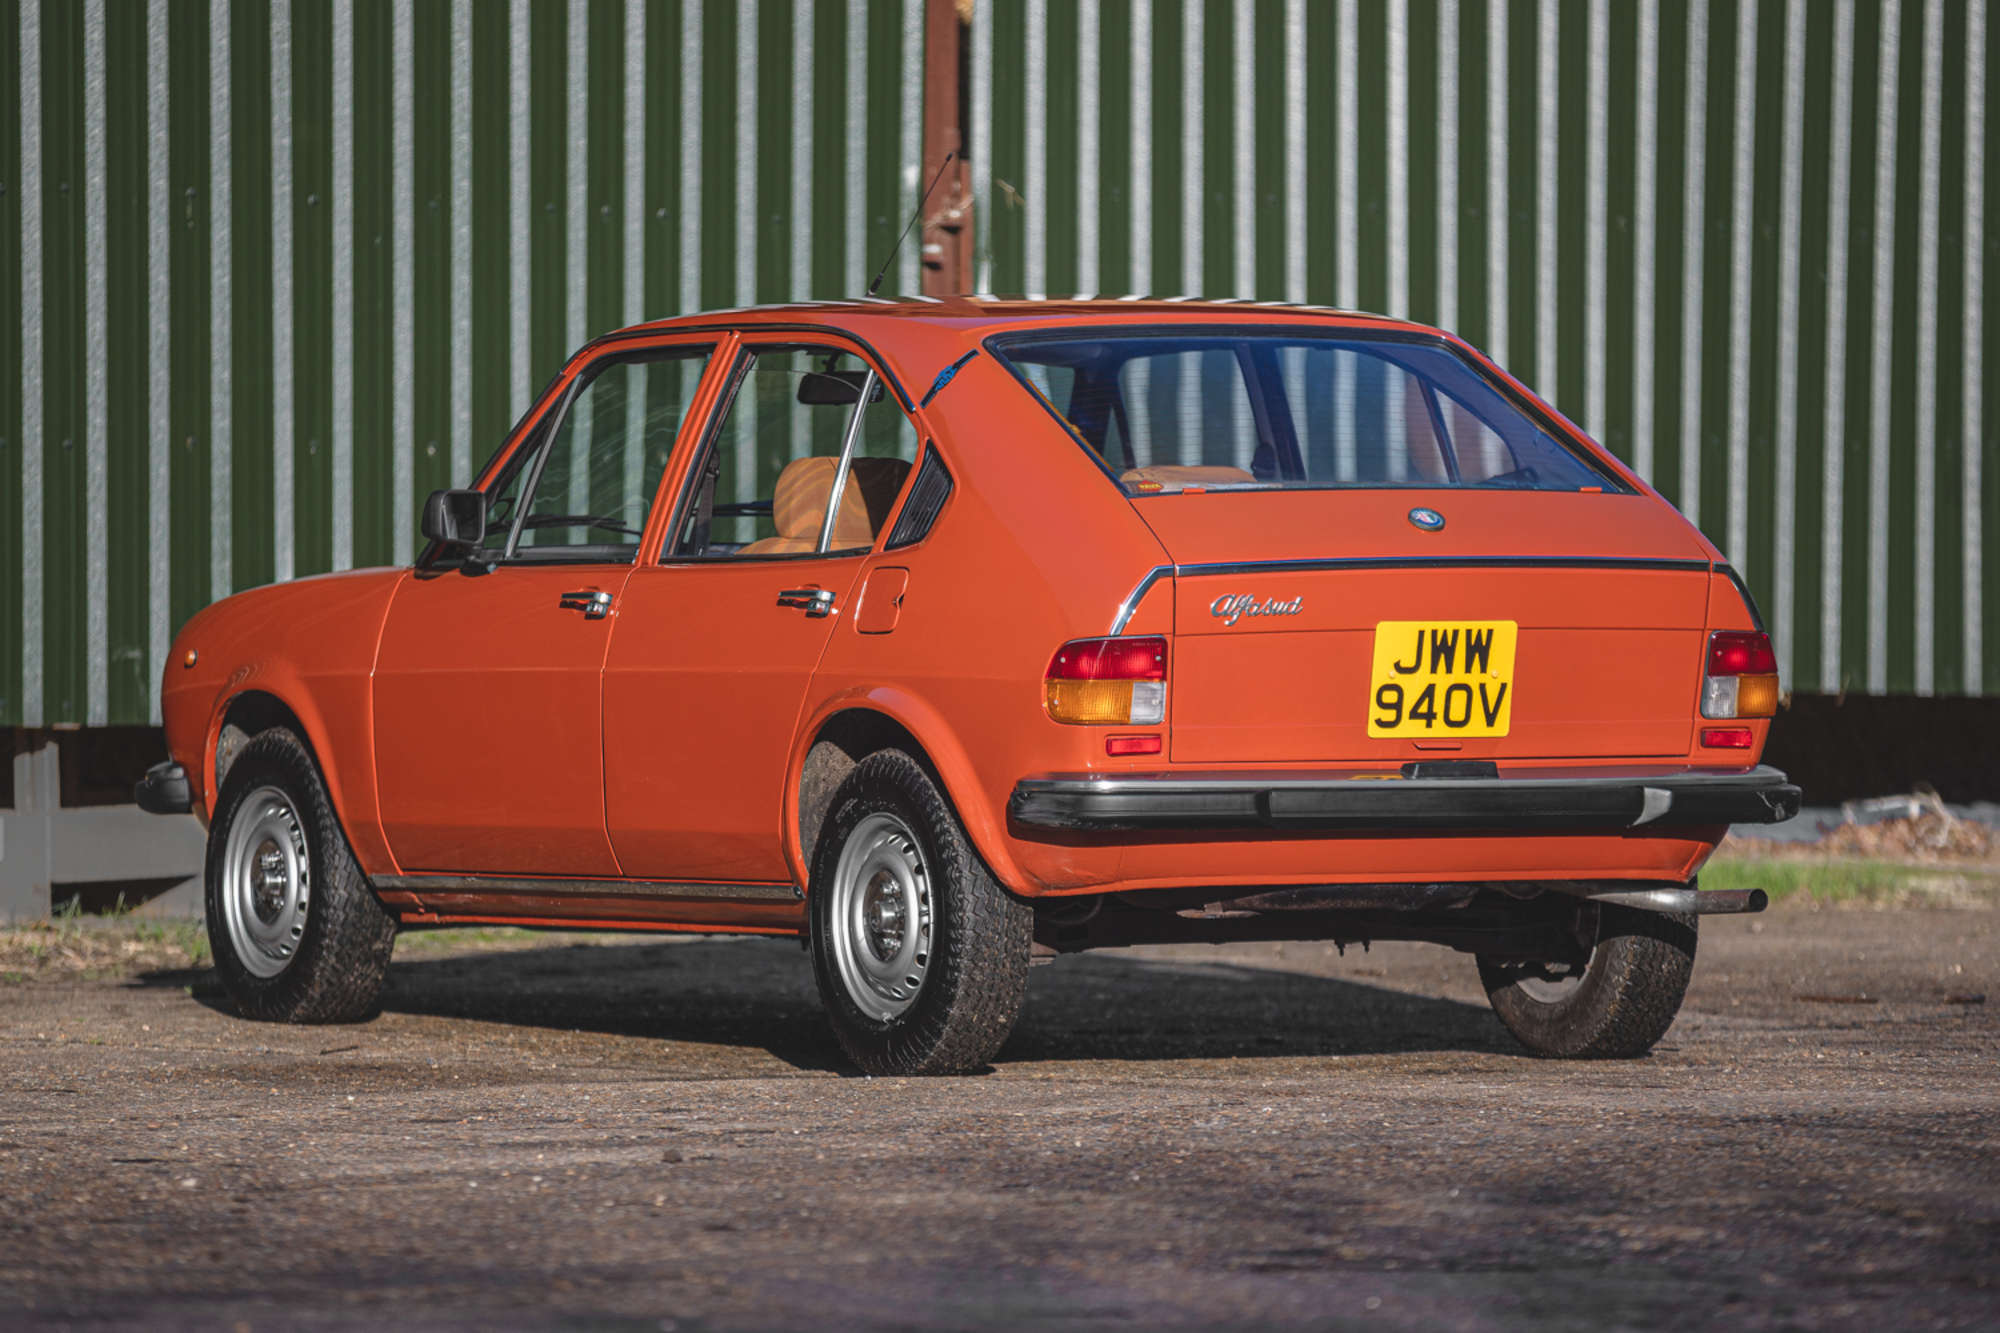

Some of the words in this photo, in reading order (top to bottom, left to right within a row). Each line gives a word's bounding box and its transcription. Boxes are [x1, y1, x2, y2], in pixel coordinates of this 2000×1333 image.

[1210, 593, 1304, 626] Alfasud
[1393, 628, 1494, 675] JWW
[1374, 682, 1508, 729] 940V
